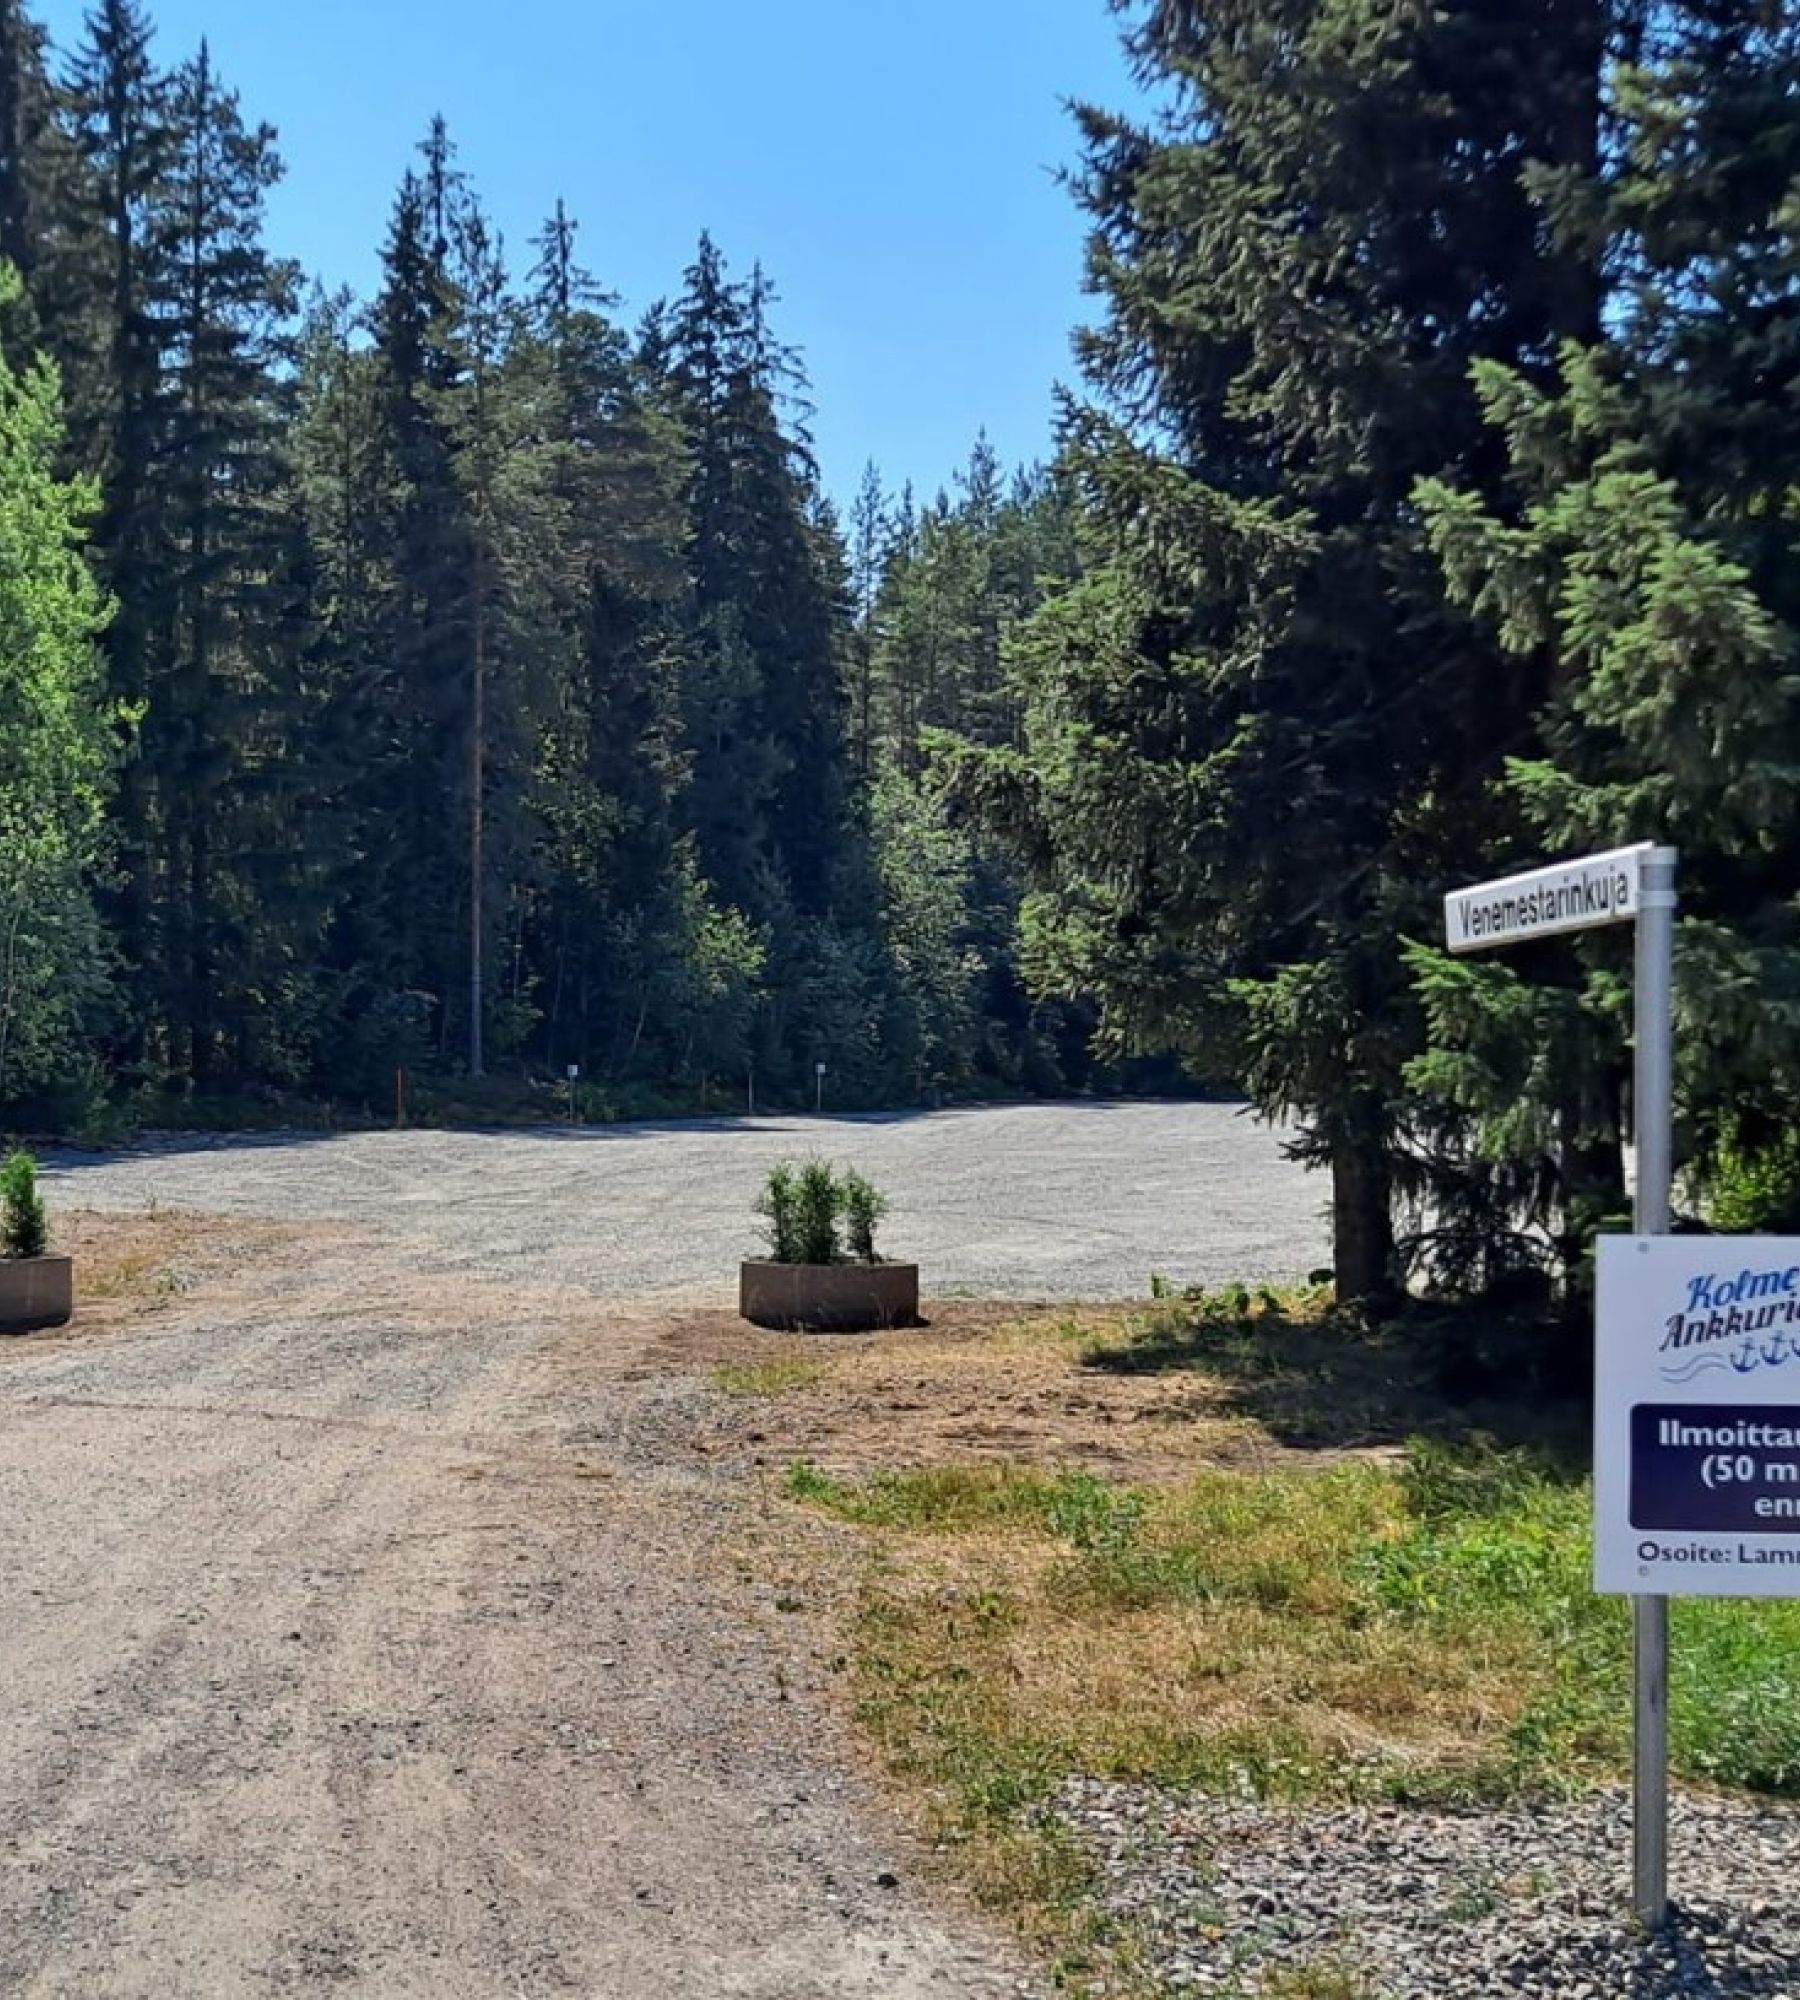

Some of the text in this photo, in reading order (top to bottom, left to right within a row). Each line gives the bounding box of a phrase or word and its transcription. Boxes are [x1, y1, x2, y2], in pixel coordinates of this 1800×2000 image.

[1458, 864, 1628, 938] Venemestarinkuja
[1686, 1265, 1799, 1313] Kolme
[1659, 1293, 1800, 1352] Ankkuri
[1701, 1454, 1798, 1489] (50 m
[1754, 1497, 1800, 1517] en
[1637, 1541, 1800, 1564] Osoite: Lam
